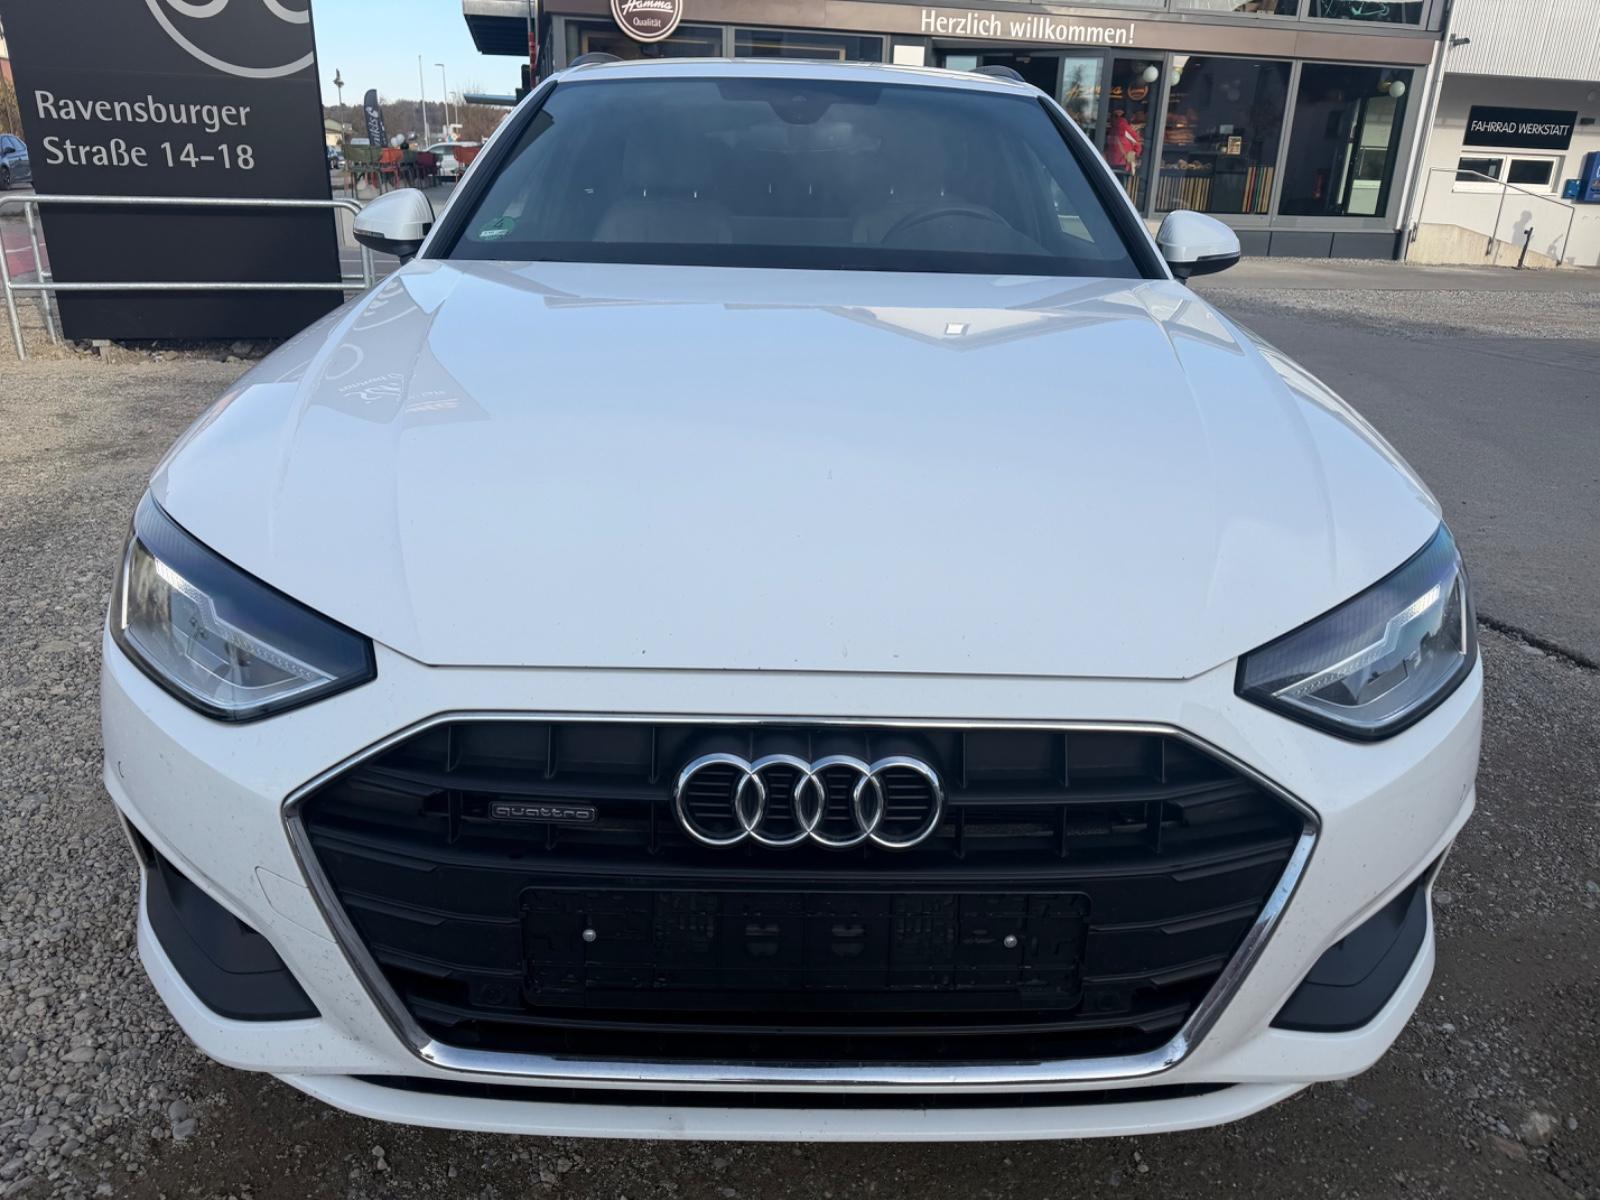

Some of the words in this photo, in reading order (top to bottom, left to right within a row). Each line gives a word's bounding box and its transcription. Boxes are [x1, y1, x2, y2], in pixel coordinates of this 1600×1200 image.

[632, 16, 661, 27] Qualität
[921, 9, 1001, 37] Herzlich
[1009, 17, 1136, 45] willkommen!
[34, 89, 251, 133] Ravensburger
[1471, 120, 1516, 133] FAHRRAD
[1518, 123, 1570, 136] WERKSTATT
[42, 136, 149, 167] Straße
[495, 807, 590, 819] quattro
